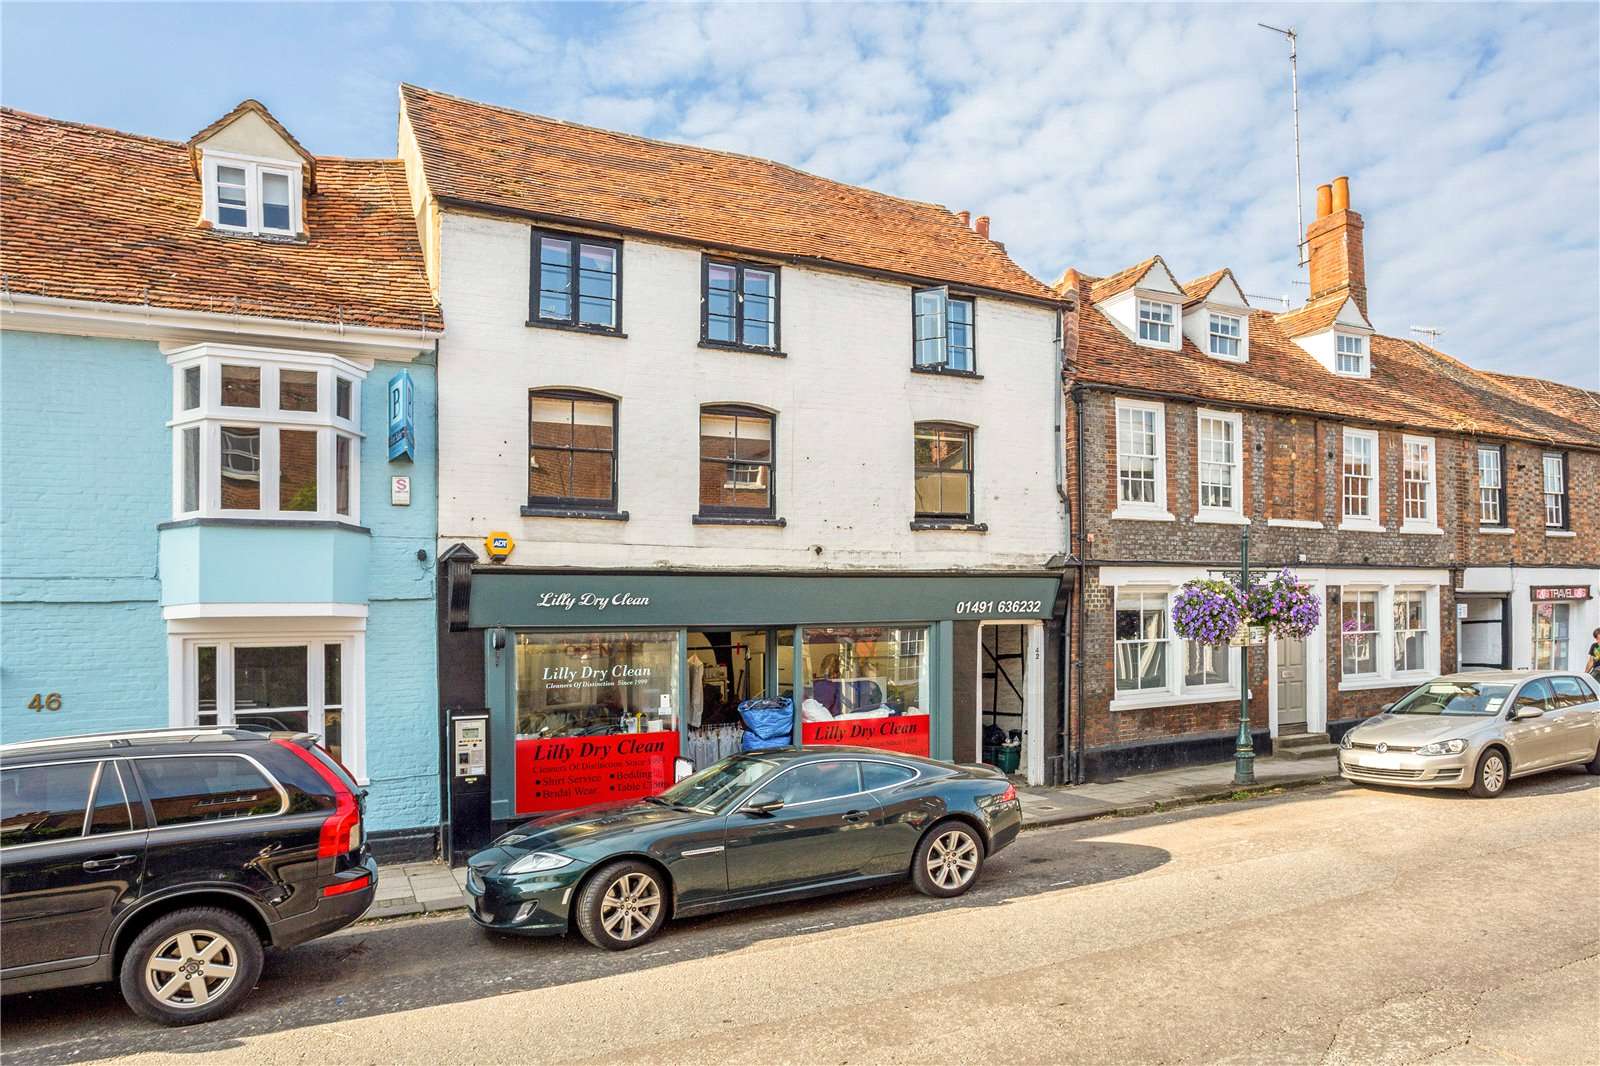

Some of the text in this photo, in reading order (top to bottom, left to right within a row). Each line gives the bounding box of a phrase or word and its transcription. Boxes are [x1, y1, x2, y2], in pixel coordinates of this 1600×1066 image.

[396, 479, 407, 490] S
[494, 540, 508, 548] ADT
[537, 592, 650, 611] Lilly Dry Clean
[956, 600, 1042, 614] 01491 636232
[543, 664, 652, 683] Lilly Dry Clean
[573, 681, 582, 689] Of
[28, 693, 63, 713] 46
[815, 726, 848, 742] Lilly
[850, 724, 876, 741] Dry
[879, 722, 918, 736] Clean
[534, 739, 665, 762] Lilly Dry Clean
